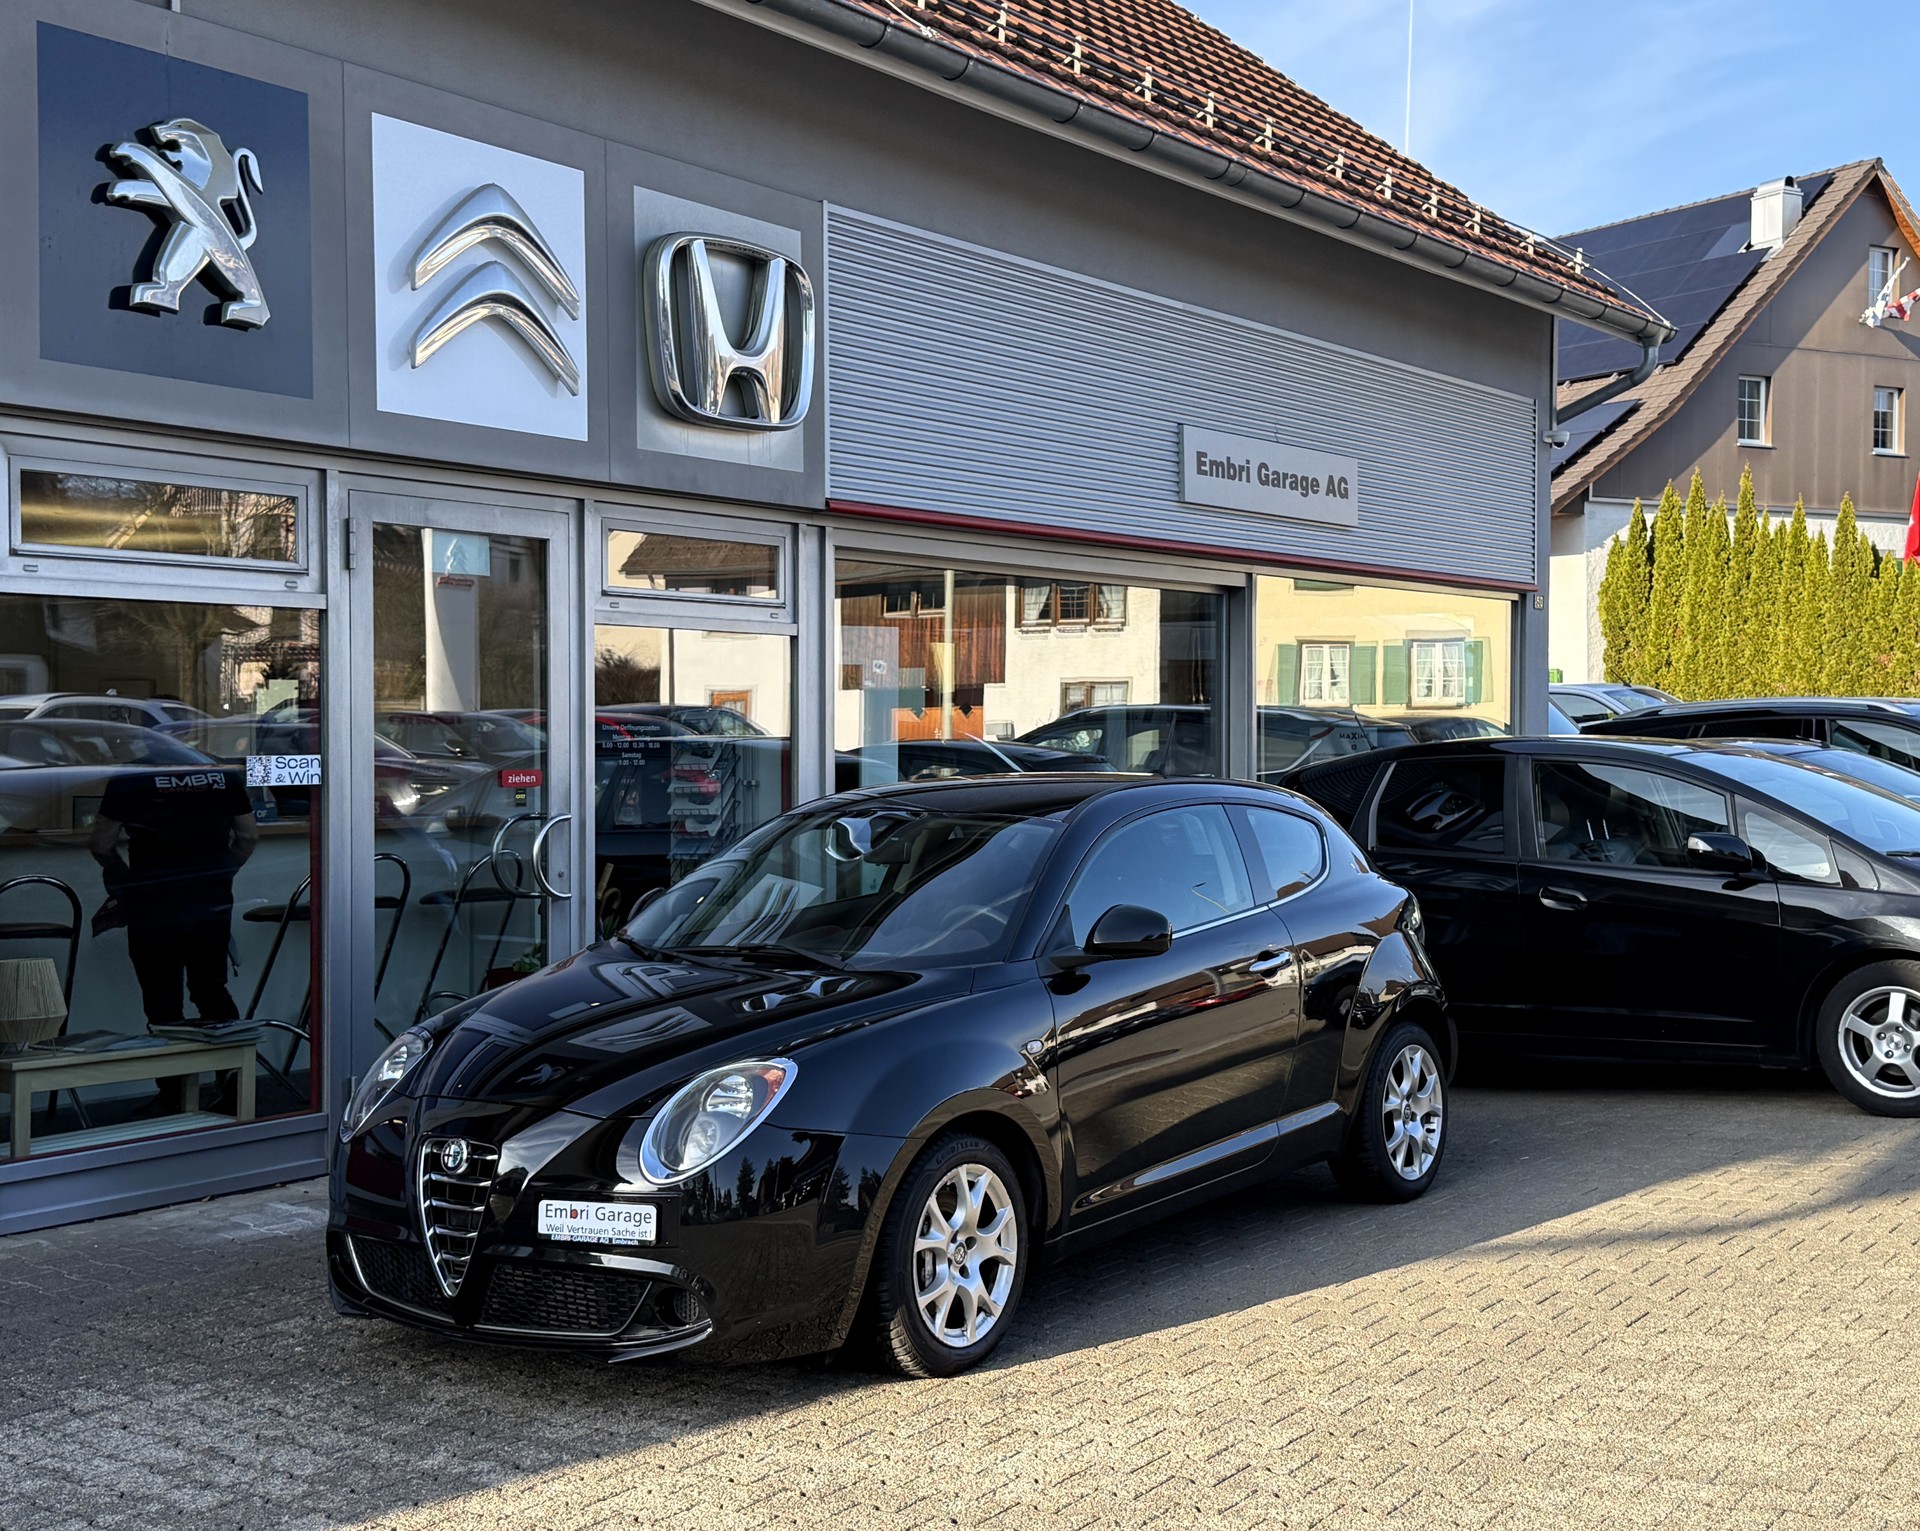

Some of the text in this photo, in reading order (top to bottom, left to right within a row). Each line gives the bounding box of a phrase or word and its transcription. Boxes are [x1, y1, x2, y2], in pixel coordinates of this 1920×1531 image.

[1196, 450, 1349, 500] Embri Garage AG
[275, 756, 321, 769] Scan
[155, 772, 226, 788] EMBRI
[275, 769, 321, 784] & Win
[508, 773, 536, 783] ziehen
[545, 1203, 652, 1228] Embri Garage
[545, 1223, 564, 1233] Weil
[566, 1224, 609, 1236] Vertrauen
[612, 1227, 636, 1237] Sache
